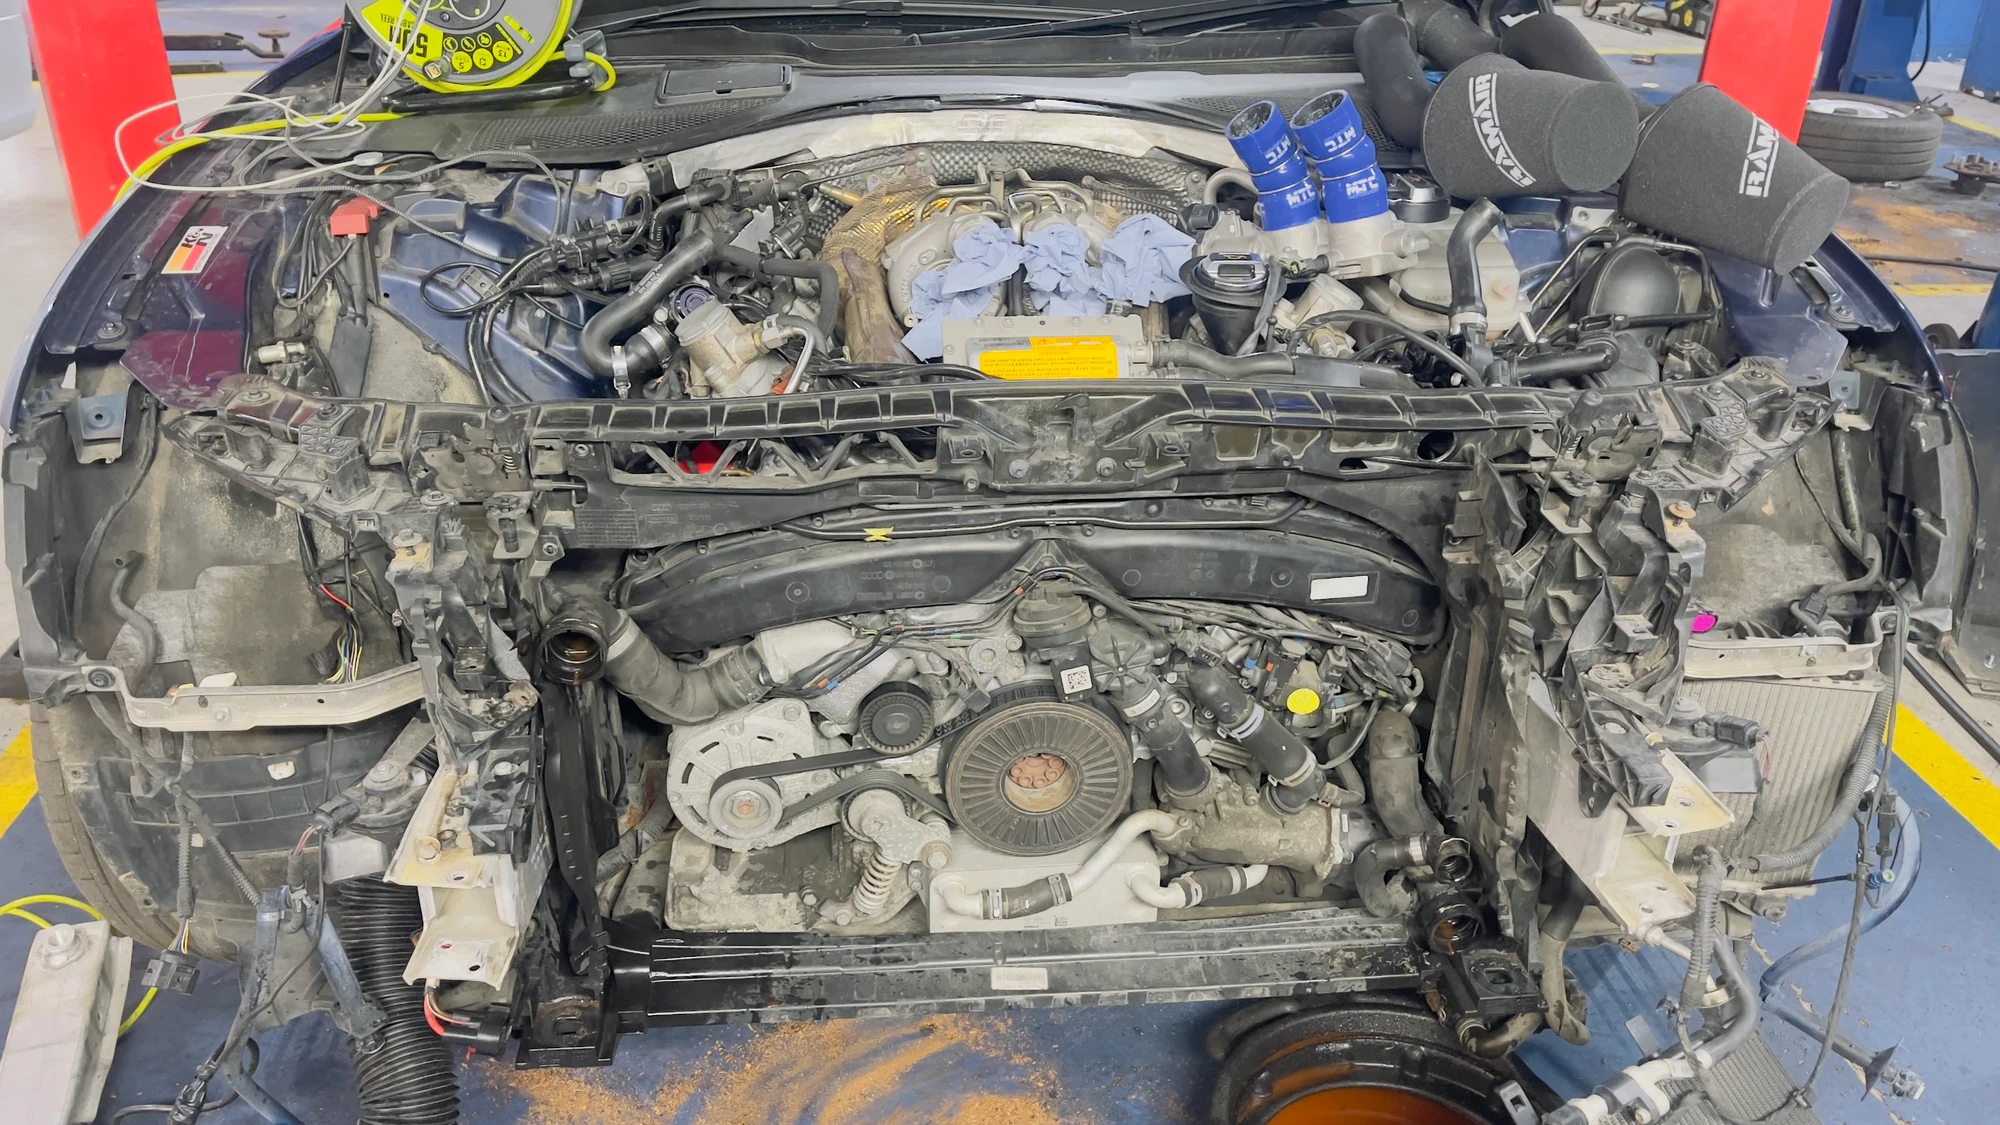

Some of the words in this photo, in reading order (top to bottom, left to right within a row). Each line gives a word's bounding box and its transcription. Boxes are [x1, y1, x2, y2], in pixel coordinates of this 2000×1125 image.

[380, 13, 395, 24] REEL
[389, 25, 428, 58] 50M
[498, 50, 507, 58] 13
[1324, 126, 1357, 153] MTC
[1472, 73, 1534, 187] RAMAIR
[1265, 136, 1291, 165] MTC
[1286, 182, 1316, 205] MTC
[1345, 175, 1379, 196] MTC
[181, 228, 213, 248] K&N
